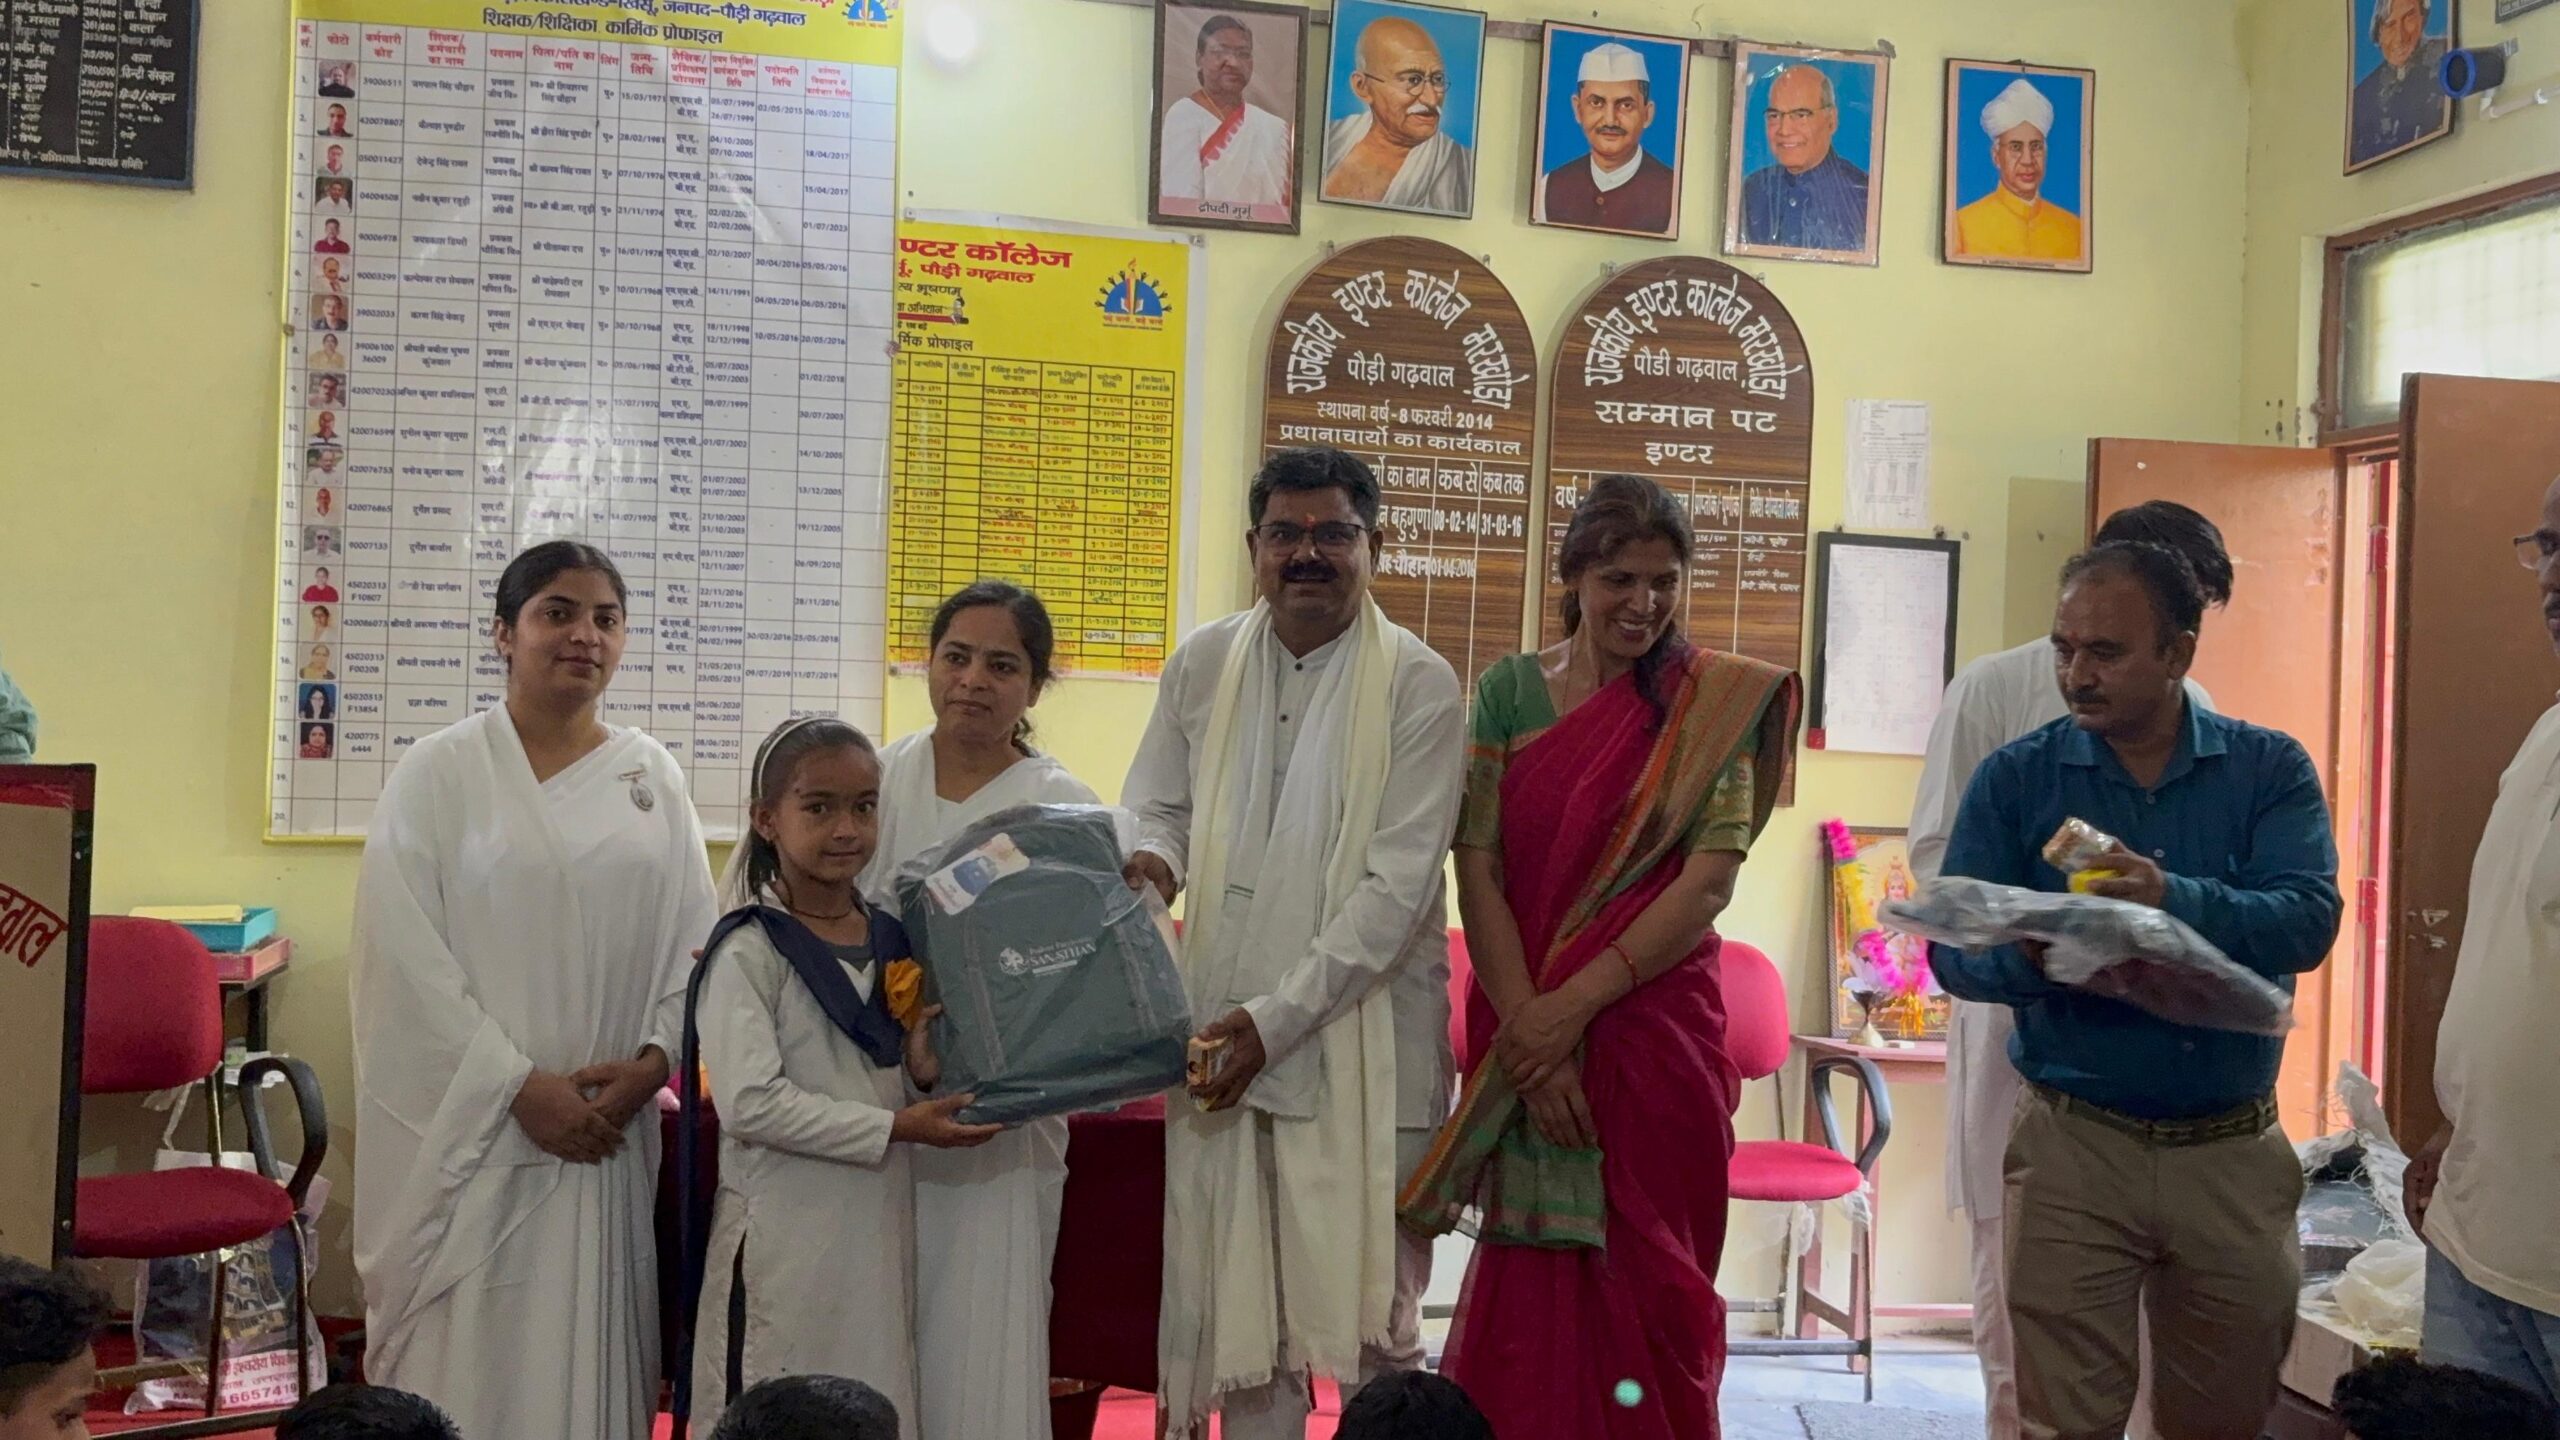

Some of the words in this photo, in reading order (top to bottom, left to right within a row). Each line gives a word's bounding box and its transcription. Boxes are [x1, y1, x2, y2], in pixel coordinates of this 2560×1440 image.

[483, 7, 597, 32] शिक्षक/शिक्षिका
[606, 18, 658, 37] कार्मिक
[663, 23, 722, 44] प्रोफाइल
[754, 9, 806, 27] गढ़वाल
[965, 241, 1072, 268] कॉलेज
[927, 333, 973, 352] प्रोफाइल
[1284, 312, 1346, 394] राजकीय
[1332, 270, 1392, 327] इण्टर
[1403, 269, 1472, 330] कालेज
[1584, 314, 1643, 386] राजकीय
[1625, 280, 1682, 334] इण्टर
[1686, 273, 1753, 334] कालेज
[1347, 350, 1385, 386] पौड़ी
[1391, 362, 1455, 389] गढ़वाल
[1676, 356, 1738, 383] गढ़वाल
[1317, 401, 1366, 422] स्थापना
[1411, 404, 1452, 427] फरवरी
[1456, 412, 1493, 430] 2014
[1595, 400, 1715, 430] सम्मान
[1730, 409, 1777, 432] पट
[1394, 432, 1422, 448] का
[1427, 432, 1521, 455] कार्यकाल
[1645, 442, 1714, 466] इण्टर
[1387, 466, 1404, 488] का
[1406, 467, 1430, 489] नाम
[1438, 469, 1463, 491] कब
[1466, 463, 1478, 492] से
[1483, 471, 1504, 494] कब
[1504, 472, 1524, 495] तक
[1555, 475, 1578, 510] वर्ष
[1391, 507, 1432, 542] बहुगुणा
[1433, 511, 1477, 533] 08-02-14
[1481, 513, 1522, 537] 31-03-16
